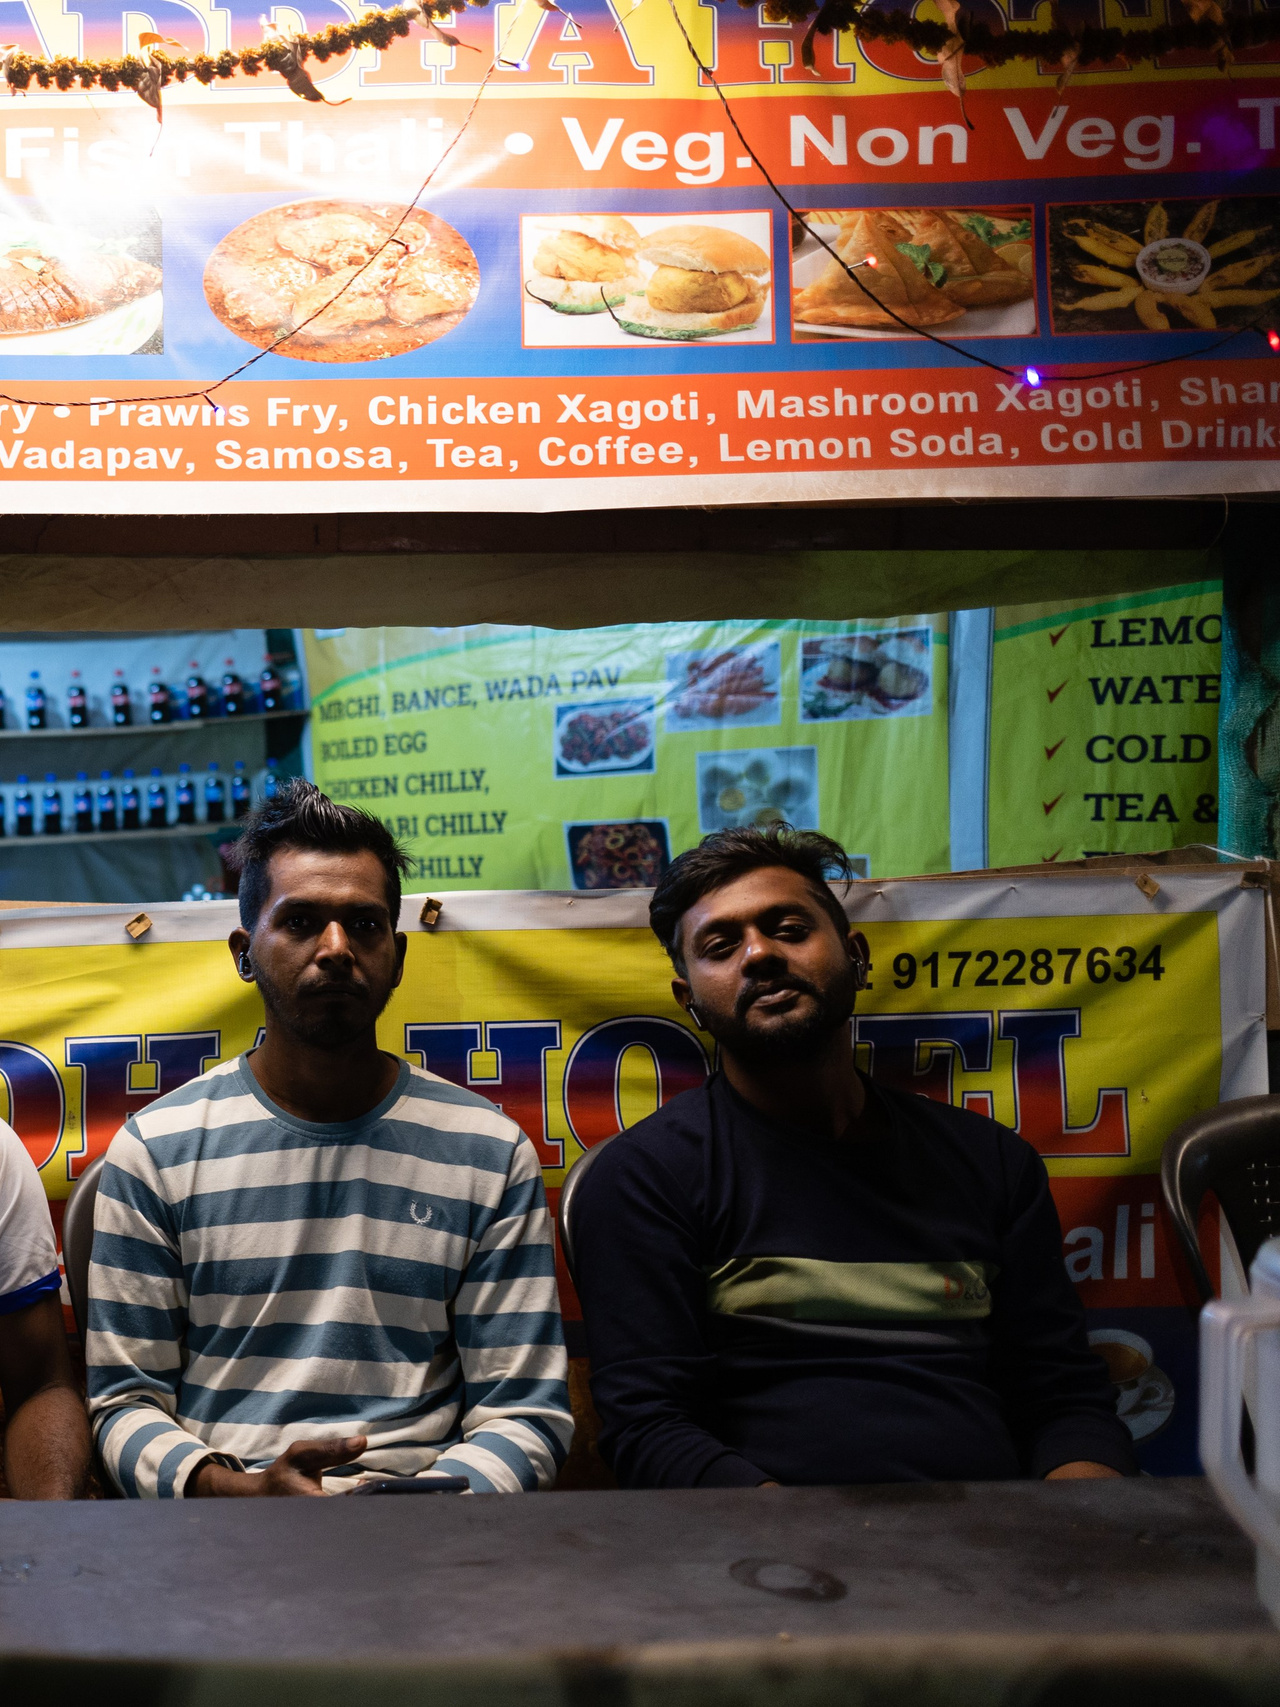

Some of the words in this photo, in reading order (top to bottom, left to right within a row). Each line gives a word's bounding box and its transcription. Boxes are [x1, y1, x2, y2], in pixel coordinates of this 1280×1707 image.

[5, 121, 193, 180] Fish
[224, 116, 445, 174] Thali
[560, 115, 752, 185] Veg.
[789, 113, 969, 168] Non
[1002, 105, 1202, 170] Veg.
[90, 398, 251, 430] Prawns
[267, 398, 349, 435] Fry,
[367, 393, 542, 428] Chicken
[555, 391, 717, 431] Xagoti,
[736, 385, 980, 420] Mashroom
[995, 378, 1160, 418] Xagoti,
[214, 439, 409, 477] Samosa,
[426, 436, 520, 475] Tea,
[537, 433, 700, 471] Coffee,
[719, 430, 873, 464] Lemon
[889, 424, 1020, 460] Soda,
[1040, 420, 1143, 453] Cold
[1161, 417, 1280, 449] Drink
[391, 683, 478, 713] BANCE,
[485, 674, 563, 702] WADA
[569, 666, 622, 693] PAV
[1088, 674, 1221, 706] WATE
[384, 730, 429, 757] EGG
[1085, 733, 1212, 764] COLD
[404, 768, 491, 797] CHILLY,
[1083, 793, 1180, 823] TEA
[424, 811, 508, 838] CHILLY
[892, 946, 1166, 989] 9172287634
